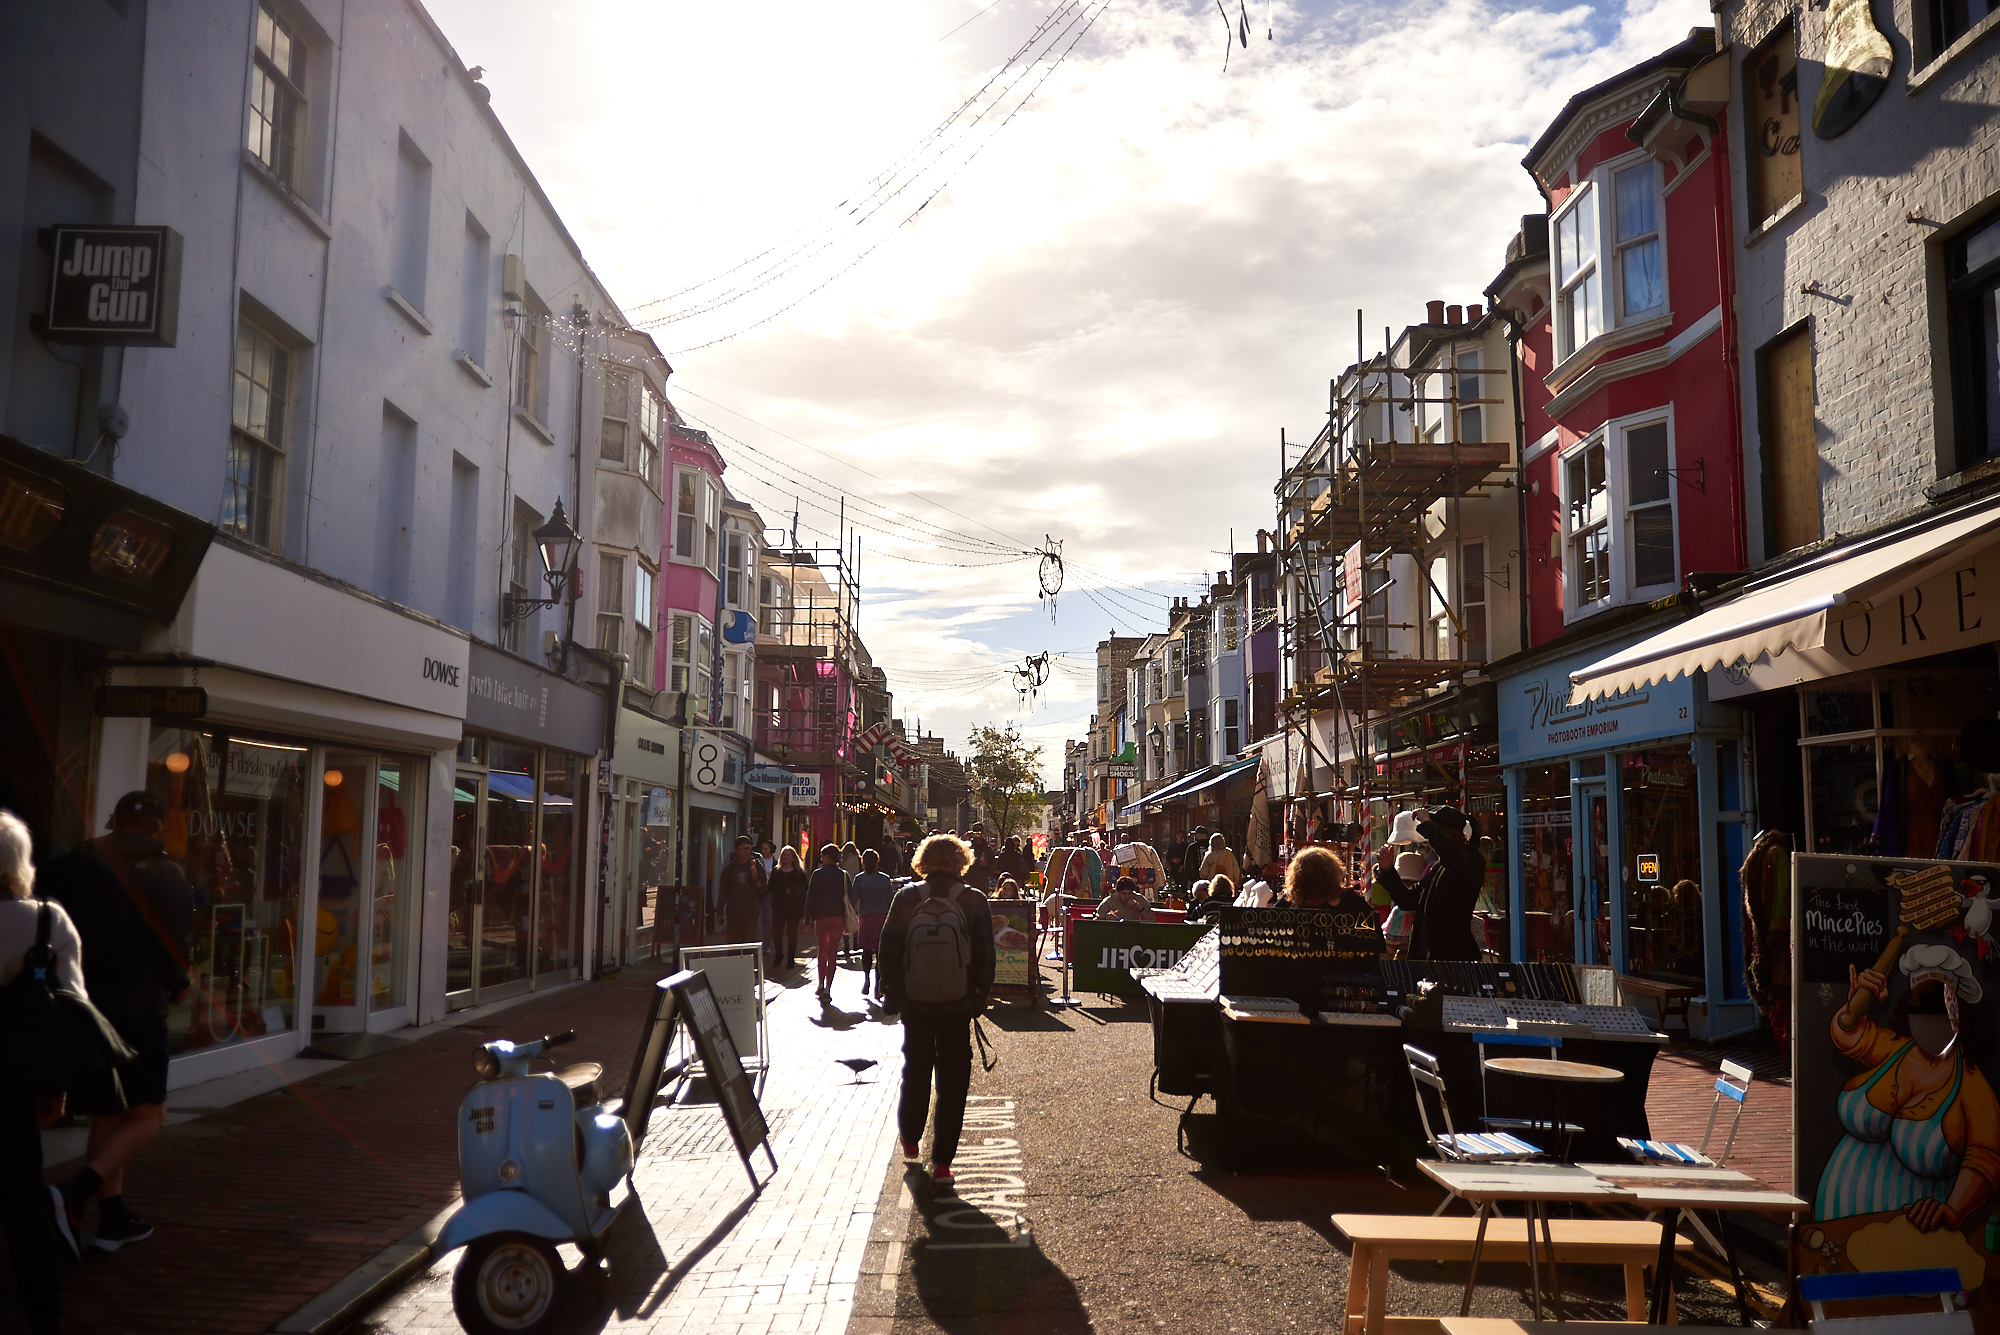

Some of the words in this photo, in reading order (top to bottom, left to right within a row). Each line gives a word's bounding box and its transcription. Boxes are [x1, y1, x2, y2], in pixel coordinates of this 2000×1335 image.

[63, 238, 151, 283] Jump
[112, 277, 129, 290] the
[88, 283, 148, 322] Gun
[423, 657, 460, 687] DOWSE
[470, 675, 491, 699] north
[514, 686, 529, 710] hair
[166, 690, 200, 713] Gun
[1679, 707, 1687, 719] 22
[1548, 726, 1586, 744] PHOTOBOOTH
[1587, 720, 1619, 738] EMPORIUM
[794, 777, 810, 786] IRD
[792, 787, 816, 796] BLEND
[190, 810, 256, 837] DOWSE
[1640, 862, 1657, 874] OPEN
[1930, 866, 1941, 874] FOR
[1809, 895, 1831, 907] The
[1837, 893, 1859, 910] best
[1942, 897, 1956, 906] THEM
[1933, 909, 1956, 922] MANNERS
[1809, 937, 1819, 948] in
[1821, 936, 1846, 952] the
[1849, 938, 1879, 953] world
[469, 1106, 494, 1122] Jump
[476, 1121, 494, 1134] Gun
